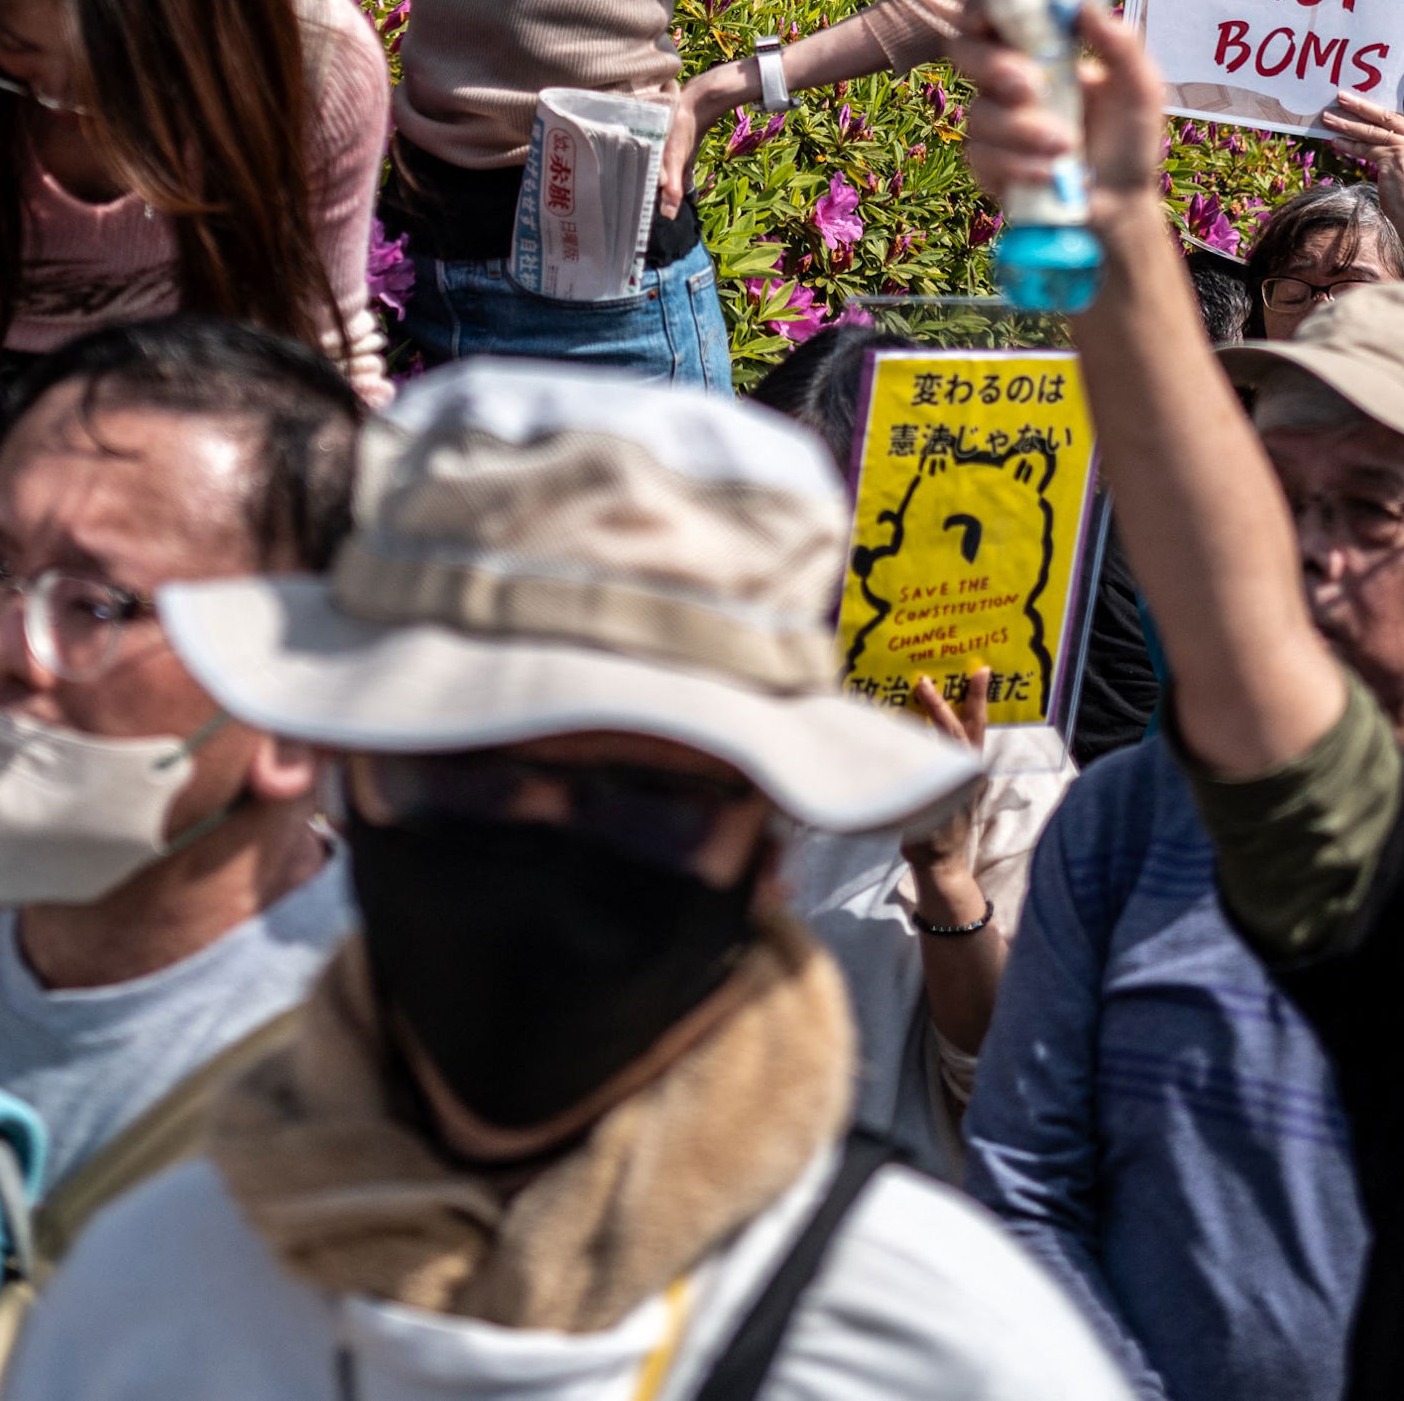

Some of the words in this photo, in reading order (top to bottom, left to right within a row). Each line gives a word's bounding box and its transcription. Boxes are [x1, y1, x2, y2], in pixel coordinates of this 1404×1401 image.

[1214, 19, 1390, 93] BOMS
[911, 372, 1067, 407] 変わるのは
[887, 423, 1073, 459] 憲法じゃない
[899, 581, 949, 603] SAVE
[959, 576, 990, 594] THE
[894, 594, 1020, 626] CONSTITUTION
[888, 624, 957, 651] CHANGE
[908, 649, 935, 663] THE
[940, 627, 1008, 658] POLITICS
